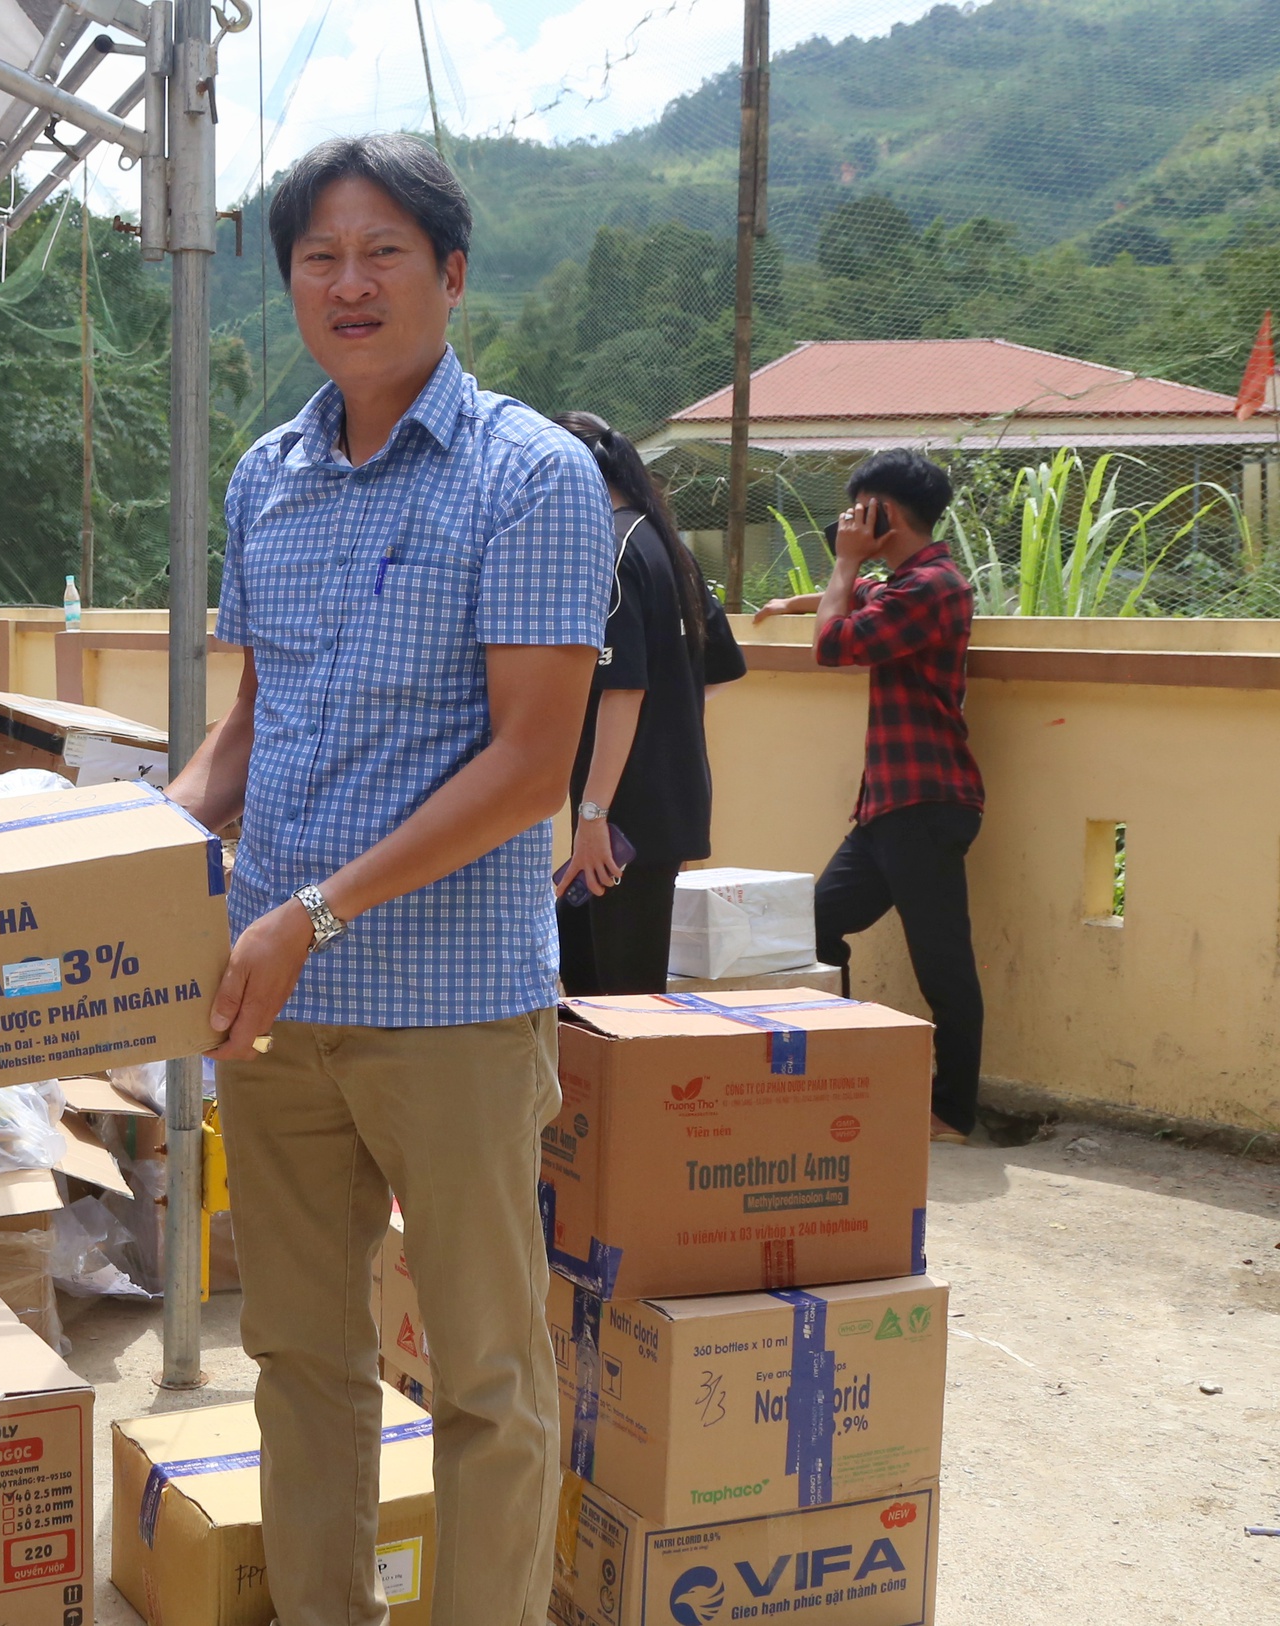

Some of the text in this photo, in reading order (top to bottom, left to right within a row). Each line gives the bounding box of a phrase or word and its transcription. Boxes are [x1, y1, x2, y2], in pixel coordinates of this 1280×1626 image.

[48, 995, 107, 1024] PHẨM
[113, 987, 169, 1013] NGÂN
[175, 979, 201, 1002] HÀ
[15, 1038, 33, 1050] Oai
[43, 1035, 59, 1046] Hà
[61, 1030, 80, 1043] Nội
[48, 1035, 157, 1062] nganhapharma.com
[686, 1126, 710, 1138] Viên
[836, 1119, 855, 1127] GMP
[835, 1130, 856, 1138] WHO
[686, 1153, 850, 1191] Tomethrol 4mg
[747, 1191, 843, 1209] Methylprednisolon 4mg
[677, 1232, 689, 1246] 10
[731, 1232, 736, 1242] x
[740, 1227, 752, 1241] 03
[789, 1226, 795, 1237] x
[798, 1222, 817, 1236] 240
[610, 1306, 659, 1349] Natri clorid
[693, 1336, 788, 1357] 360 bottles x 10 ml
[756, 1371, 773, 1383] Eye
[832, 1374, 870, 1414] orid
[16, 1493, 22, 1503] 4
[34, 1490, 49, 1500] 2.5
[51, 1484, 72, 1496] mm
[691, 1482, 763, 1505] Traphaco
[17, 1507, 24, 1517] 5
[35, 1504, 51, 1513] 2.0
[53, 1499, 74, 1511] mm
[888, 1508, 909, 1522] NEW
[17, 1522, 23, 1531] 5
[34, 1516, 50, 1528] 2.5
[52, 1513, 72, 1525] mm
[654, 1538, 675, 1549] NATRI
[677, 1534, 702, 1547] CLORID
[25, 1544, 53, 1561] 220
[733, 1537, 906, 1598] VIFA
[731, 1605, 758, 1620] Gieo
[762, 1598, 790, 1617] hạnh
[794, 1593, 822, 1612] phúc
[847, 1582, 877, 1600] thành
[880, 1578, 907, 1594] công
